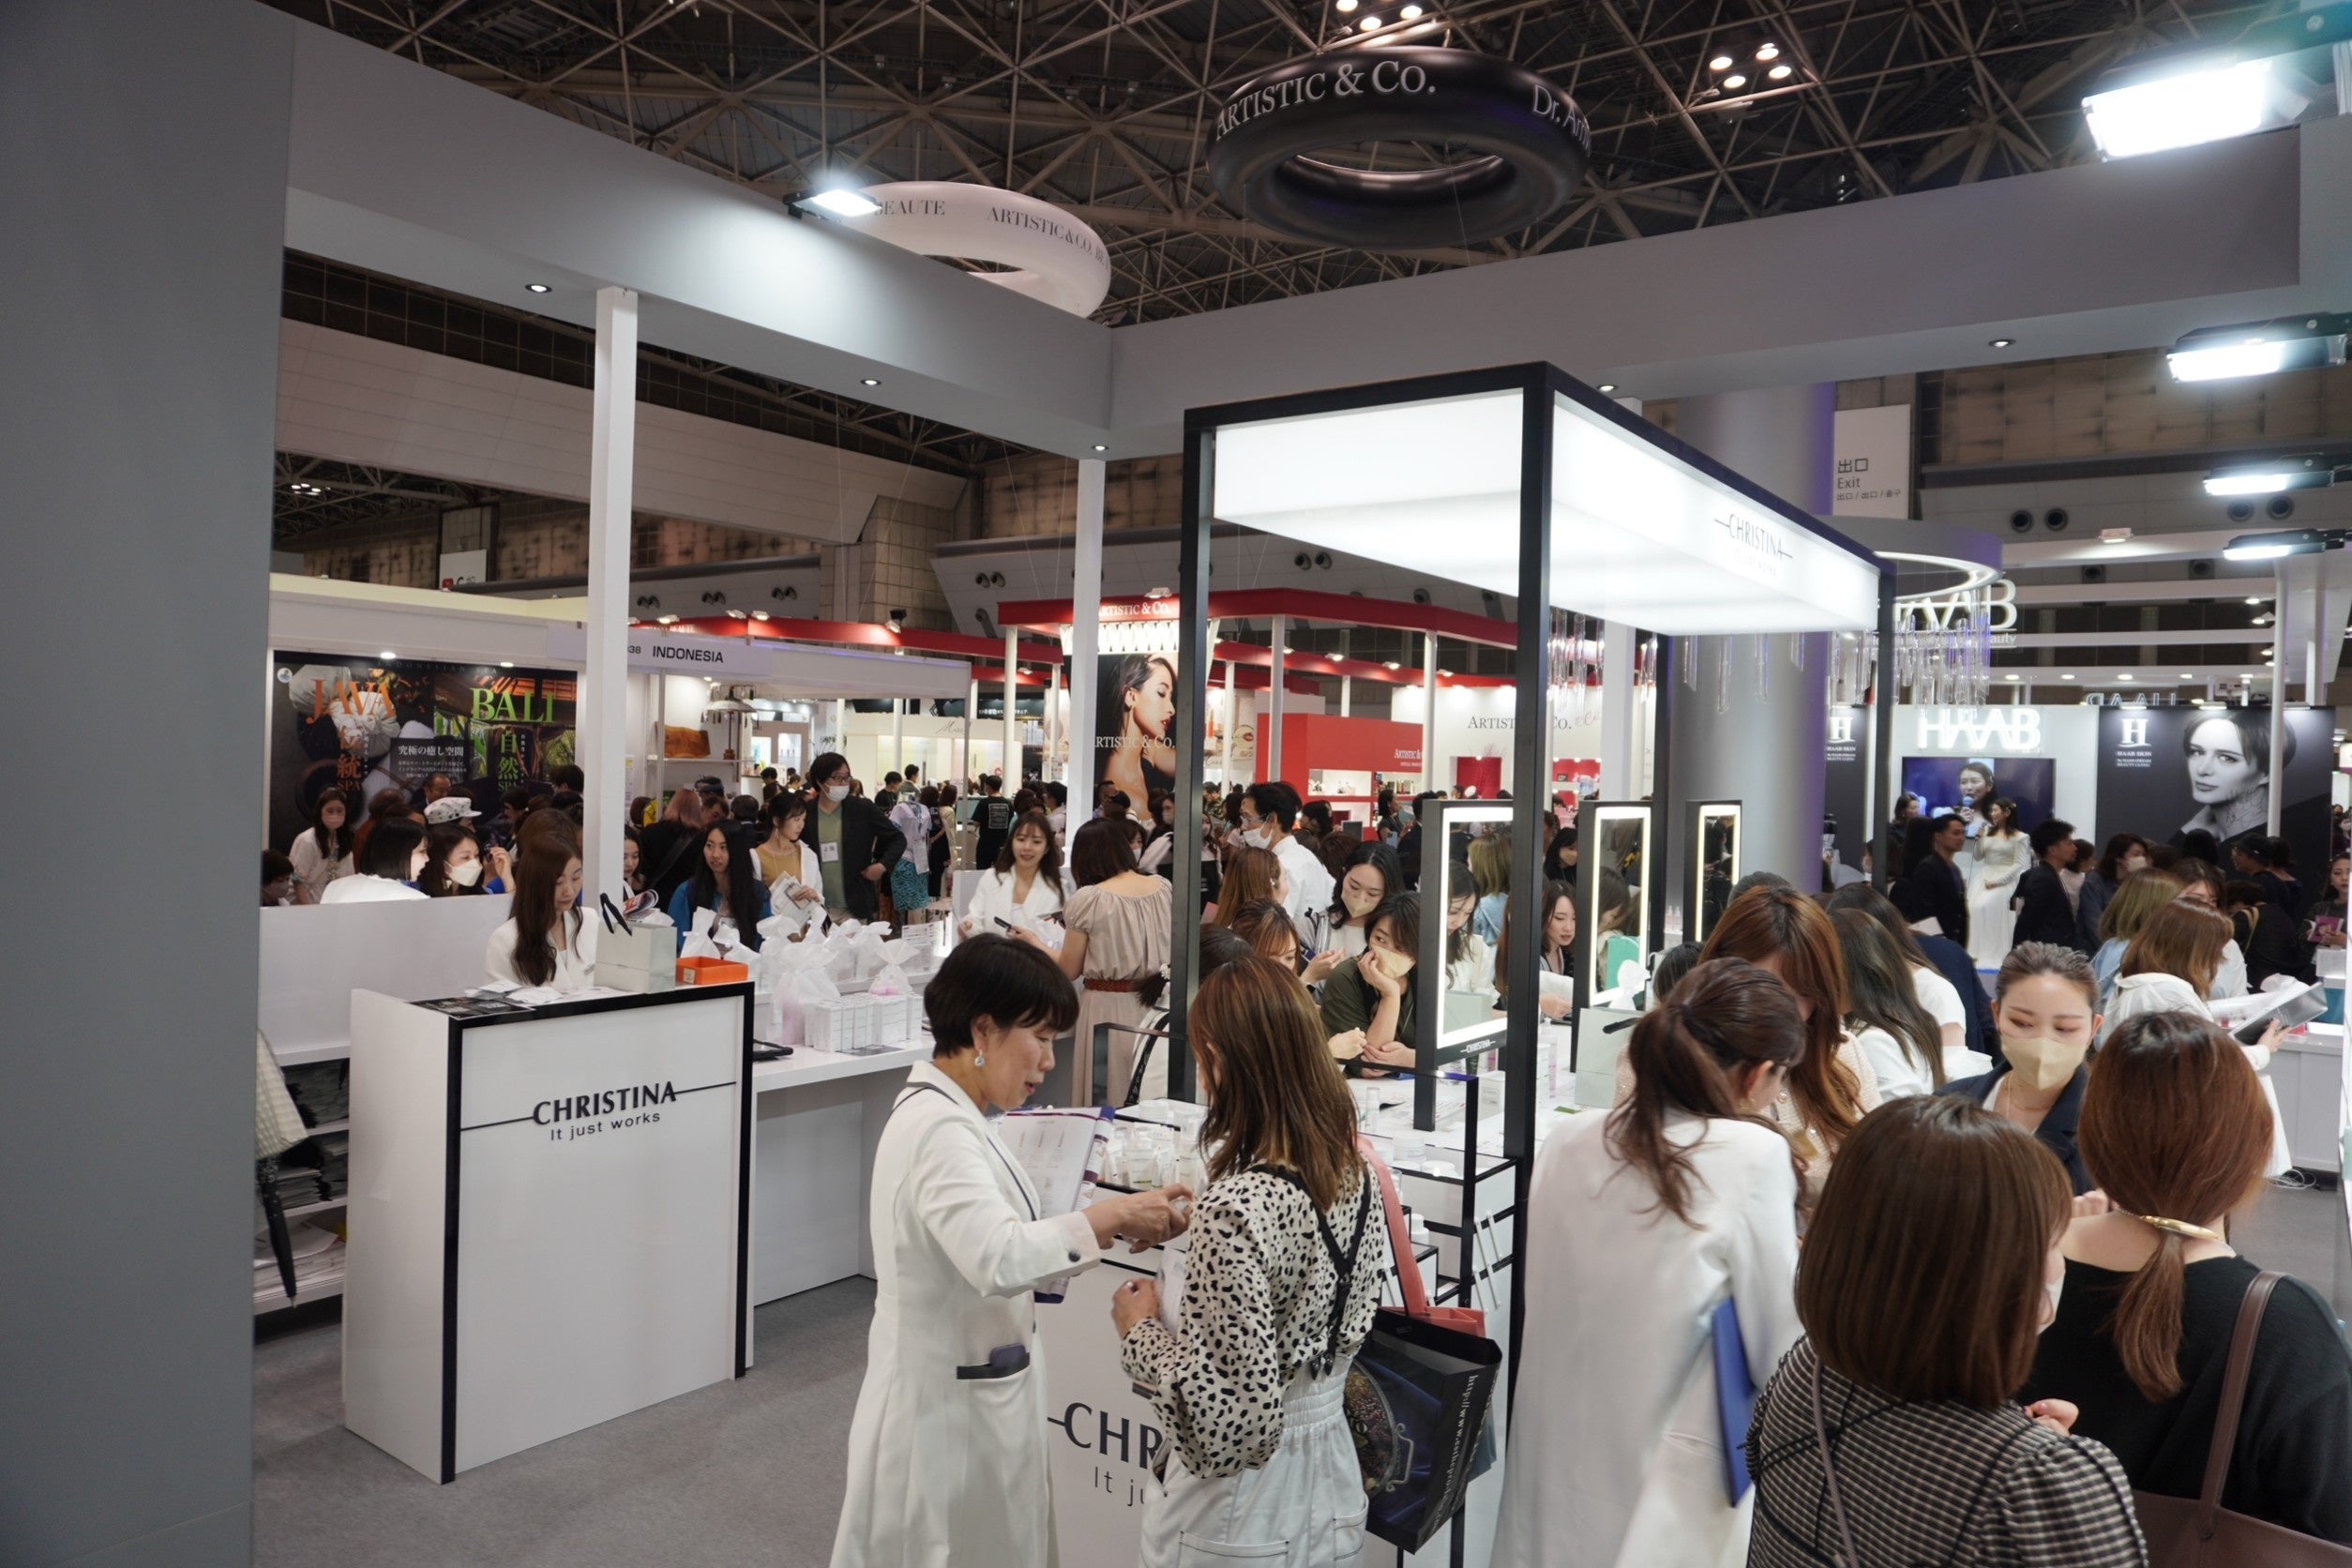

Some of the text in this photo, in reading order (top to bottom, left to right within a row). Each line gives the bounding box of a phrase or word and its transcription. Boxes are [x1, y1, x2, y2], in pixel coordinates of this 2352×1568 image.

[1216, 72, 1326, 142] ARTISTIC
[1334, 63, 1364, 97] &
[1532, 84, 1560, 123] Dr.
[1838, 458, 1869, 474] 出口
[1838, 476, 1861, 489] Exit
[1728, 513, 1783, 561] CHRISTINA
[1098, 604, 1140, 616] RTISTIC
[627, 645, 724, 663] 38 INDONESIA
[306, 678, 398, 725] JAVA
[470, 687, 556, 723] BALI
[498, 731, 519, 780] 自然
[1093, 736, 1140, 748] RTISTIC
[533, 1081, 677, 1125] CHRISTINA
[550, 1110, 660, 1140] It just works
[1094, 1466, 1113, 1493] It
